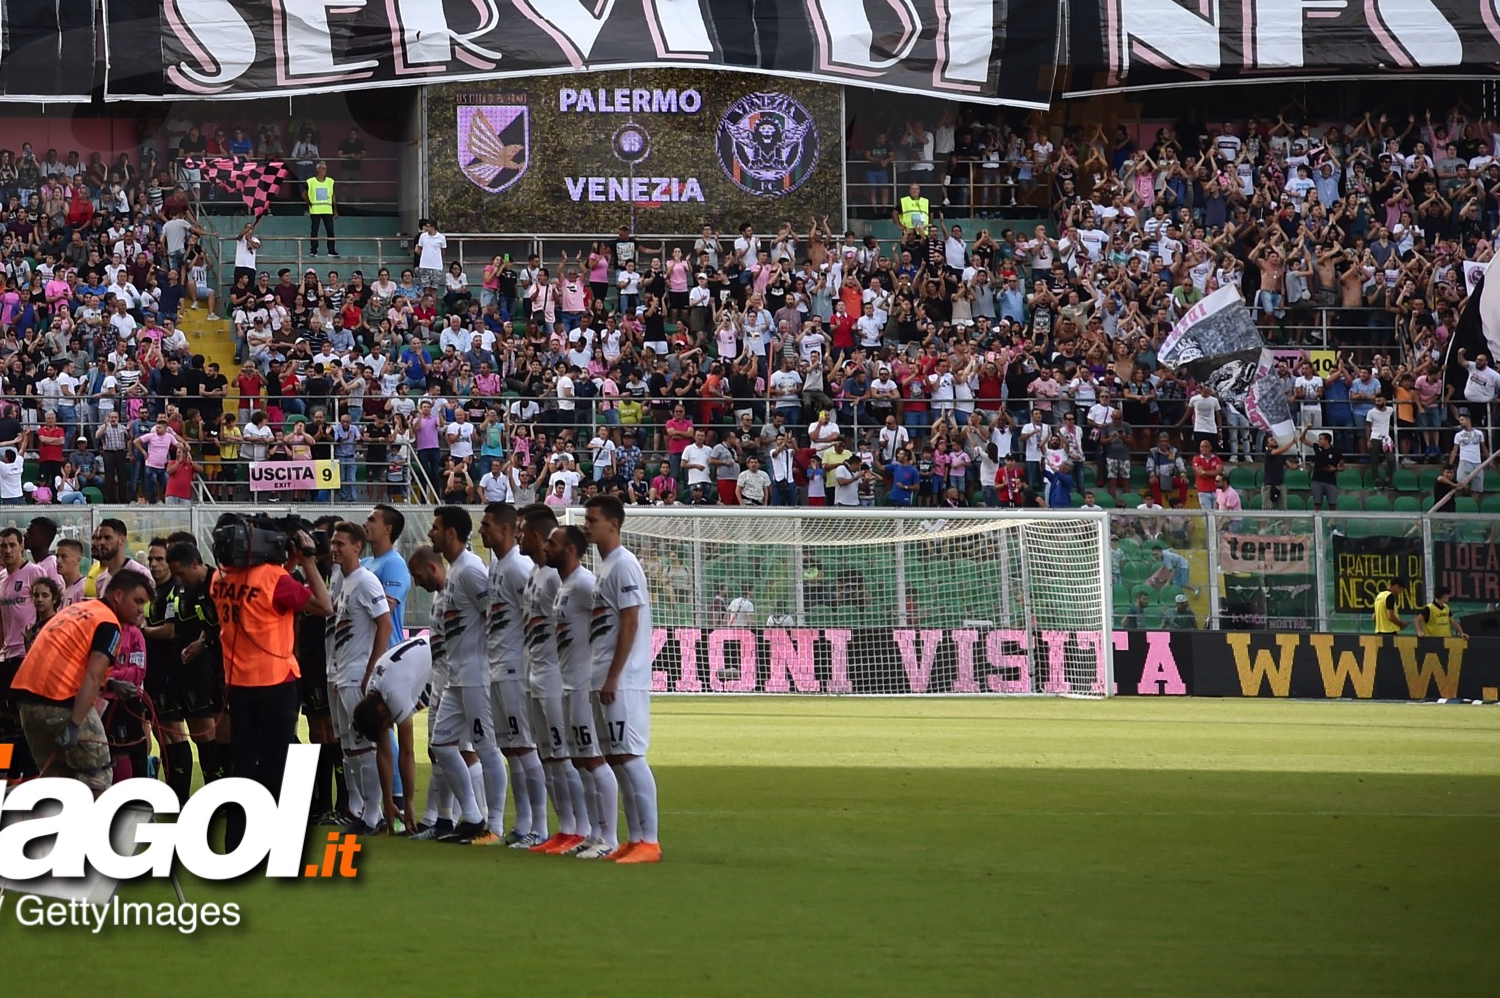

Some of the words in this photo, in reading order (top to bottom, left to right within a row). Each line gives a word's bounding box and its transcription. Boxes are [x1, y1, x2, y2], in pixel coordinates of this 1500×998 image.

[559, 87, 702, 113] PALERMO
[564, 176, 705, 202] VENEZIA
[1314, 357, 1334, 373] 10
[251, 466, 315, 482] USCITA
[322, 468, 333, 482] 9
[1339, 553, 1399, 578] FRATELLI
[1408, 555, 1423, 578] DI
[211, 581, 261, 602] STAFF
[222, 605, 241, 624] 36
[893, 629, 1187, 695] VISITA
[473, 718, 484, 737] 4
[508, 716, 519, 735] 9
[608, 721, 625, 742] 17
